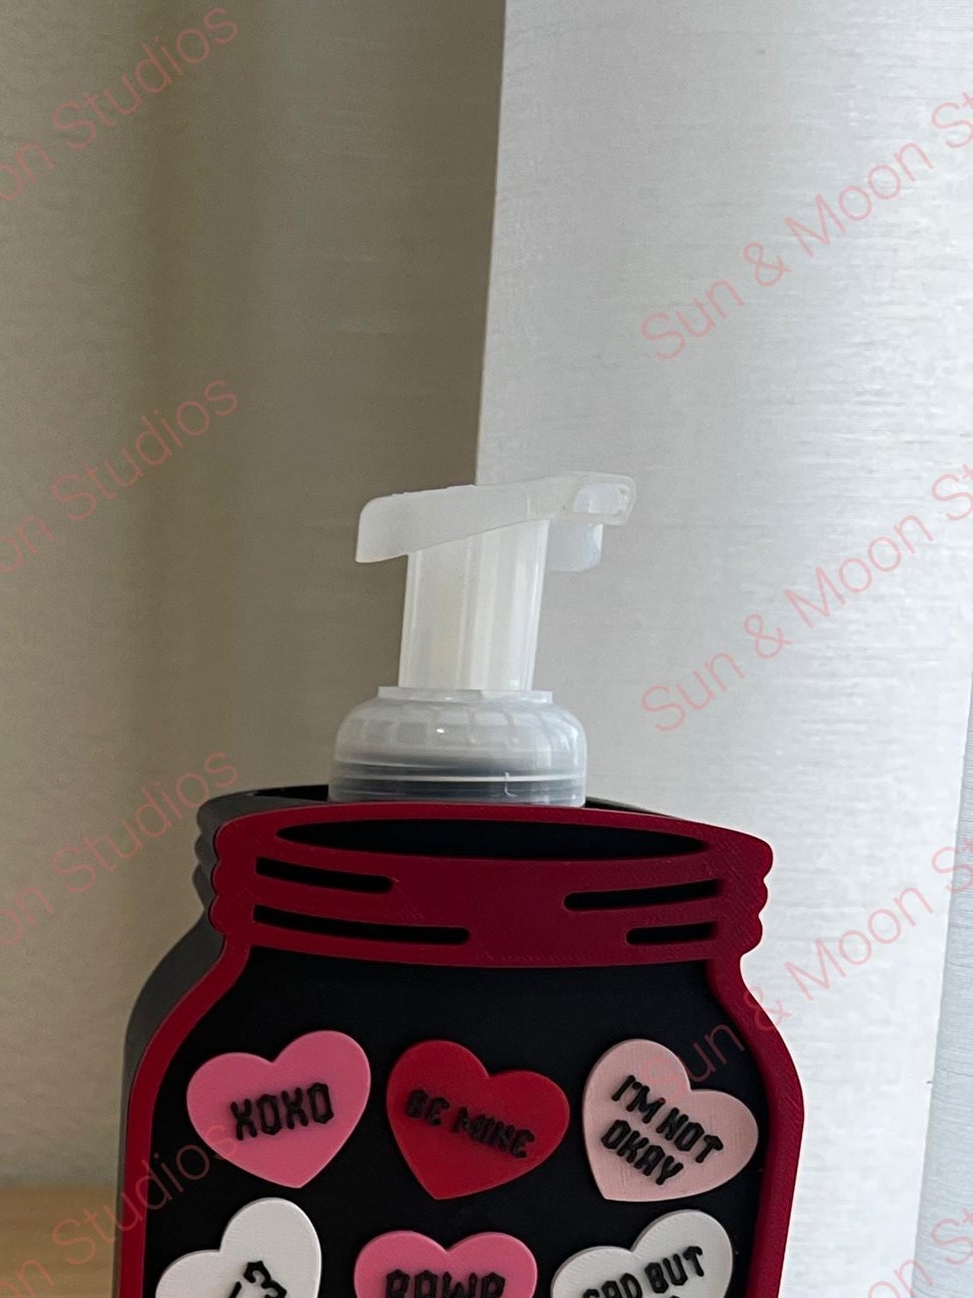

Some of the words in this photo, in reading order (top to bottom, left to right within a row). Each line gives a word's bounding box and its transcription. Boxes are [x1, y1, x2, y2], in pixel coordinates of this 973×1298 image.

[231, 1082, 334, 1141] XOXO
[404, 1088, 450, 1127] BE
[452, 1106, 536, 1159] MINE
[611, 1074, 666, 1125] I'M
[656, 1106, 724, 1165] NOT
[600, 1119, 684, 1185] OKAY
[644, 1245, 705, 1295] BUT
